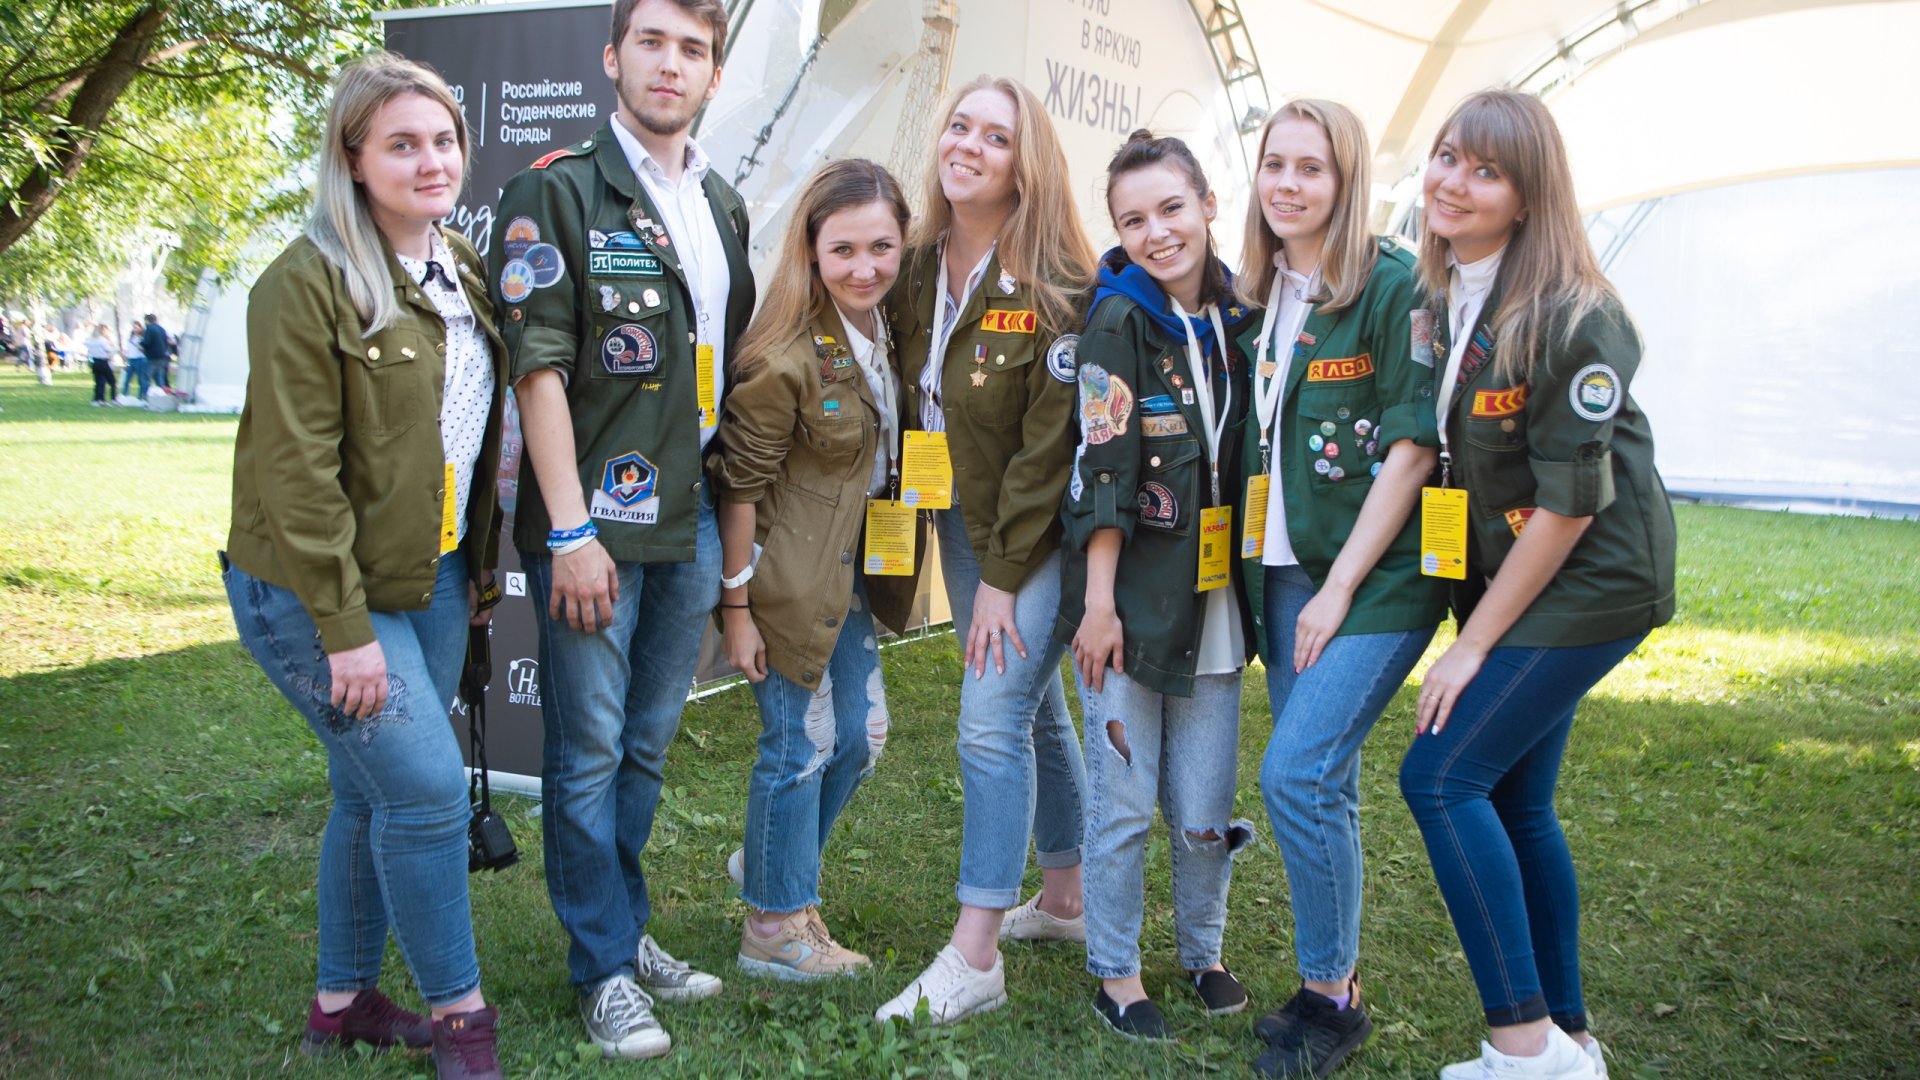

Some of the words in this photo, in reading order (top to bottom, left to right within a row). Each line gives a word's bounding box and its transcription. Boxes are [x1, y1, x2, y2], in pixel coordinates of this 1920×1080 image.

[1081, 18, 1091, 50] В
[1094, 25, 1141, 69] ЯРКУЮ
[501, 79, 583, 100] Российские
[500, 102, 597, 124] Студенческие
[499, 125, 552, 146] Отряды
[612, 257, 658, 269] ПОЛИТЕХ
[592, 506, 656, 521] ГВАРДИЯ
